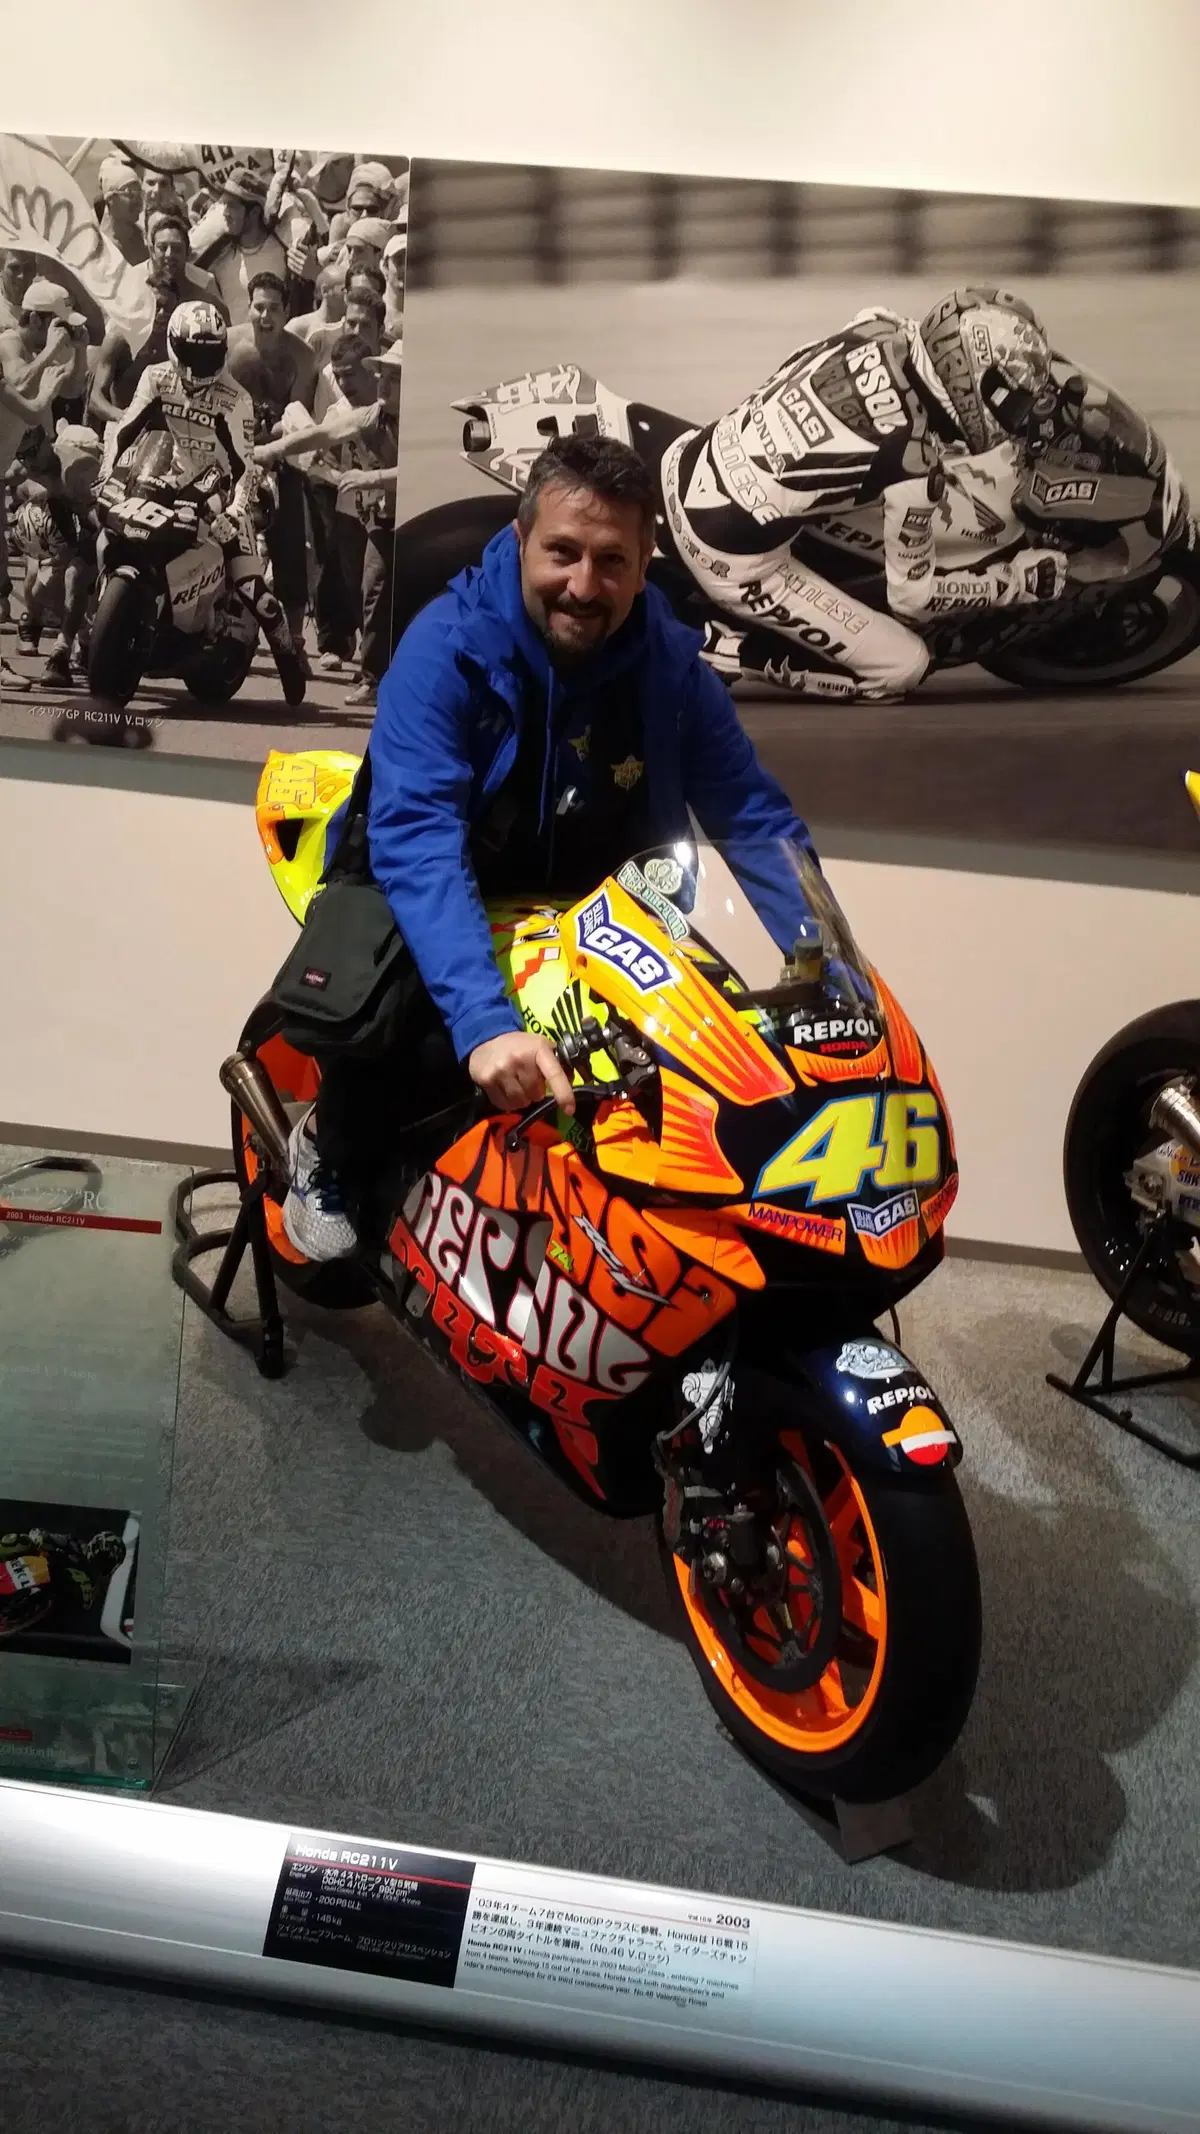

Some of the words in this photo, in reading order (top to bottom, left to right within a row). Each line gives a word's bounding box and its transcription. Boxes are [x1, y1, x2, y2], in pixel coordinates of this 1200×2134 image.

[782, 388, 826, 442] GAS
[750, 396, 787, 477] HONDA
[1046, 481, 1093, 502] GAS
[109, 497, 175, 528] 46
[739, 580, 849, 657] REPSOL
[28, 705, 80, 720] イタリアGP
[84, 710, 120, 724] RC211V
[585, 926, 665, 984] GAS
[793, 1018, 878, 1045] REPSOL
[819, 1041, 868, 1054] HONDA
[752, 1089, 942, 1208] 46
[6, 1210, 24, 1220] 2003
[28, 1213, 54, 1223] Honda
[56, 1215, 85, 1226] RC211V
[748, 1202, 843, 1242] MANPOWER
[866, 1386, 935, 1415] REPSOL
[291, 1861, 318, 1874] エンジン
[295, 1843, 337, 1861] Honda
[340, 1849, 398, 1870] RC211V
[716, 1913, 750, 1929] 2003
[467, 1937, 490, 1949] Honda
[493, 1942, 521, 1954] RC211V
[528, 1948, 549, 1959] Honda
